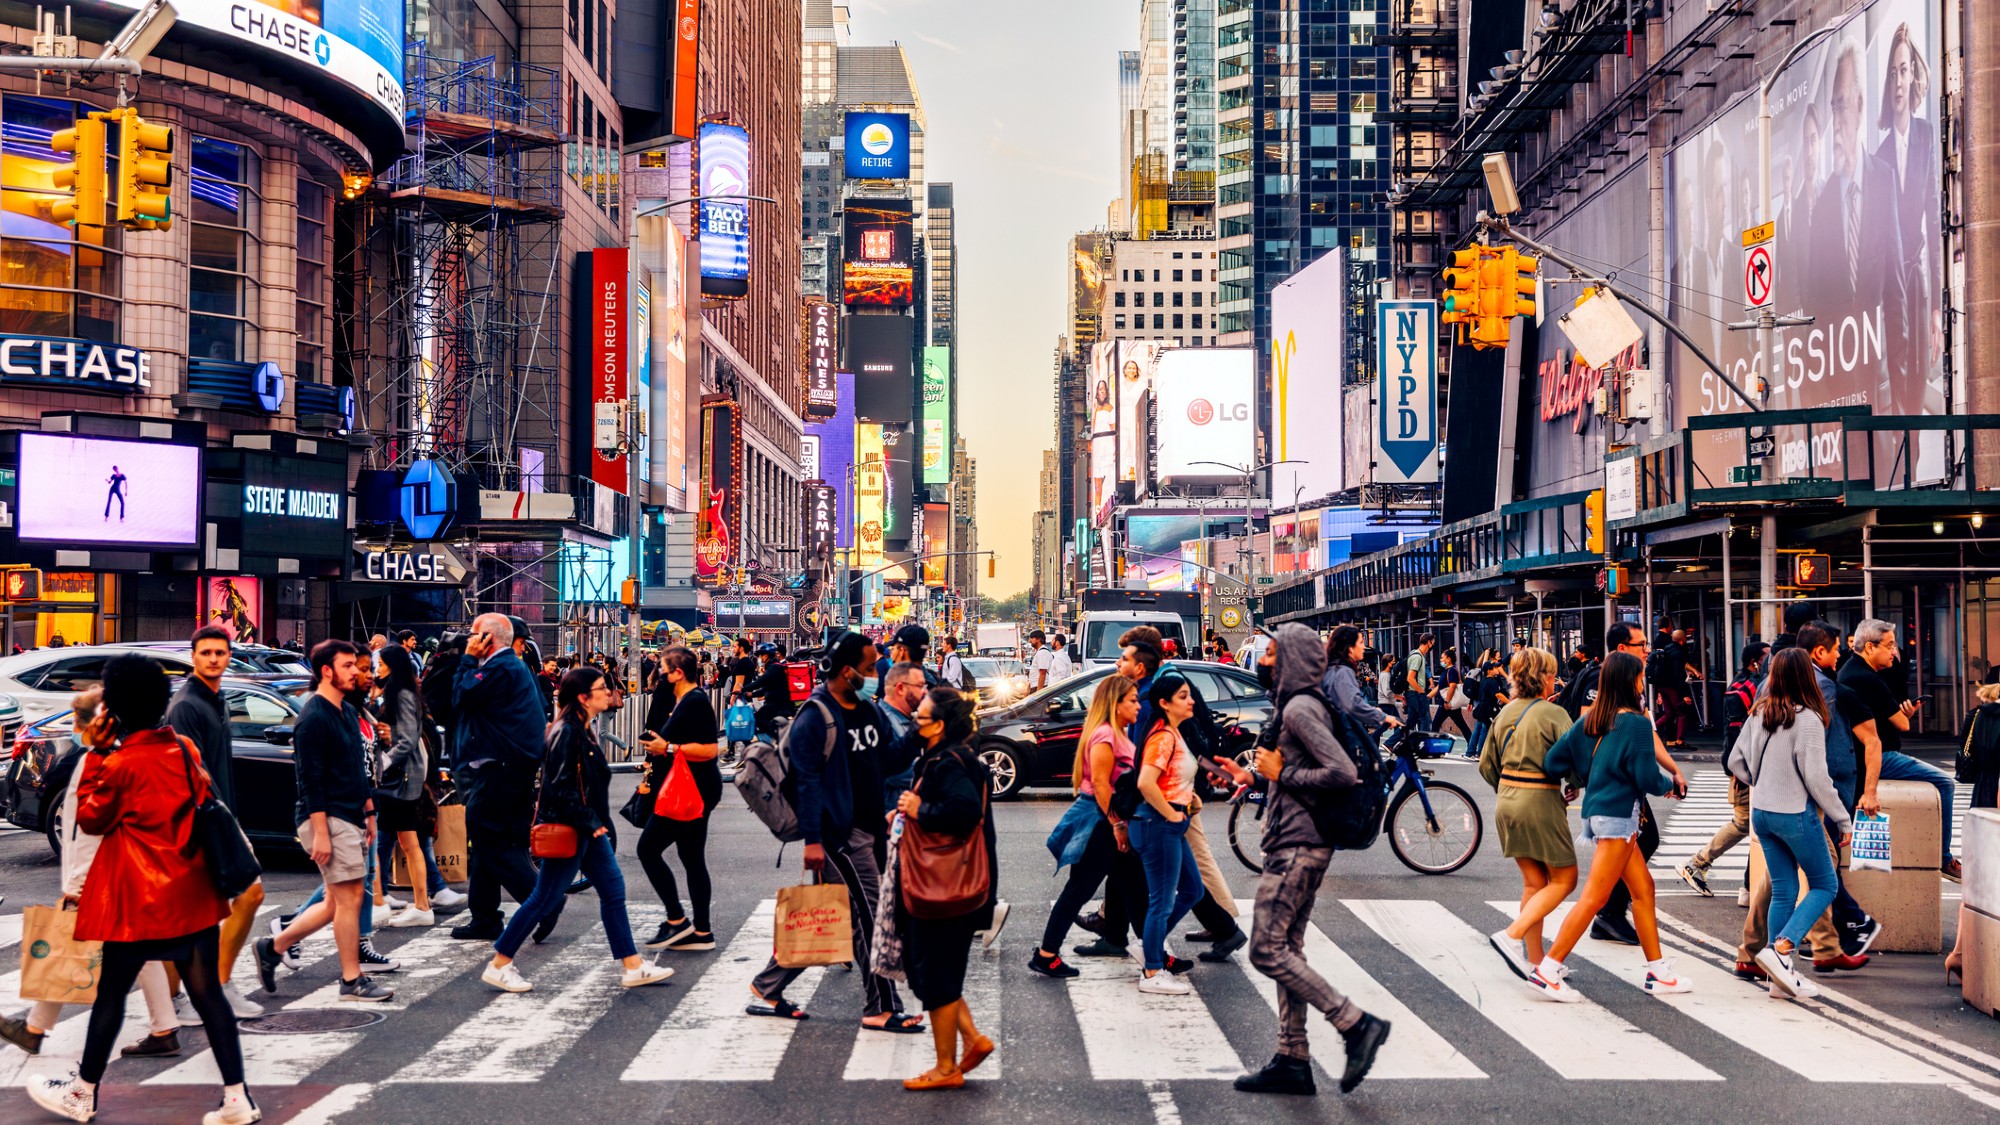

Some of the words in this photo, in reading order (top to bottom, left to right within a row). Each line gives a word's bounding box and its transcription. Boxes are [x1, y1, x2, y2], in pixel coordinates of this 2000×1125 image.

[231, 4, 310, 57] CHASE
[376, 72, 402, 117] CHASE
[1769, 98, 1784, 117] OUR
[1786, 81, 1808, 107] MOVE
[861, 157, 893, 168] RETIRE
[706, 206, 744, 222] TACO
[708, 221, 744, 236] BELL
[1751, 227, 1765, 241] NEW
[604, 281, 617, 348] REUTERS
[815, 306, 829, 389] CARMINES
[1, 340, 152, 388] CHASE
[863, 364, 894, 372] SAMSUNG
[604, 352, 617, 404] OMSON
[1396, 311, 1418, 439] NYPD
[1219, 402, 1249, 422] LG
[865, 452, 879, 463] NOW
[861, 464, 883, 473] PLAYING
[245, 485, 286, 515] STEVE
[288, 489, 340, 520] MADDEN
[698, 543, 713, 554] Hard
[712, 543, 727, 556] Rock
[365, 551, 447, 582] CHASE
[755, 585, 773, 594] Rock
[1215, 587, 1232, 596] U.S.
[848, 724, 880, 752] XO
[449, 854, 460, 866] 21
